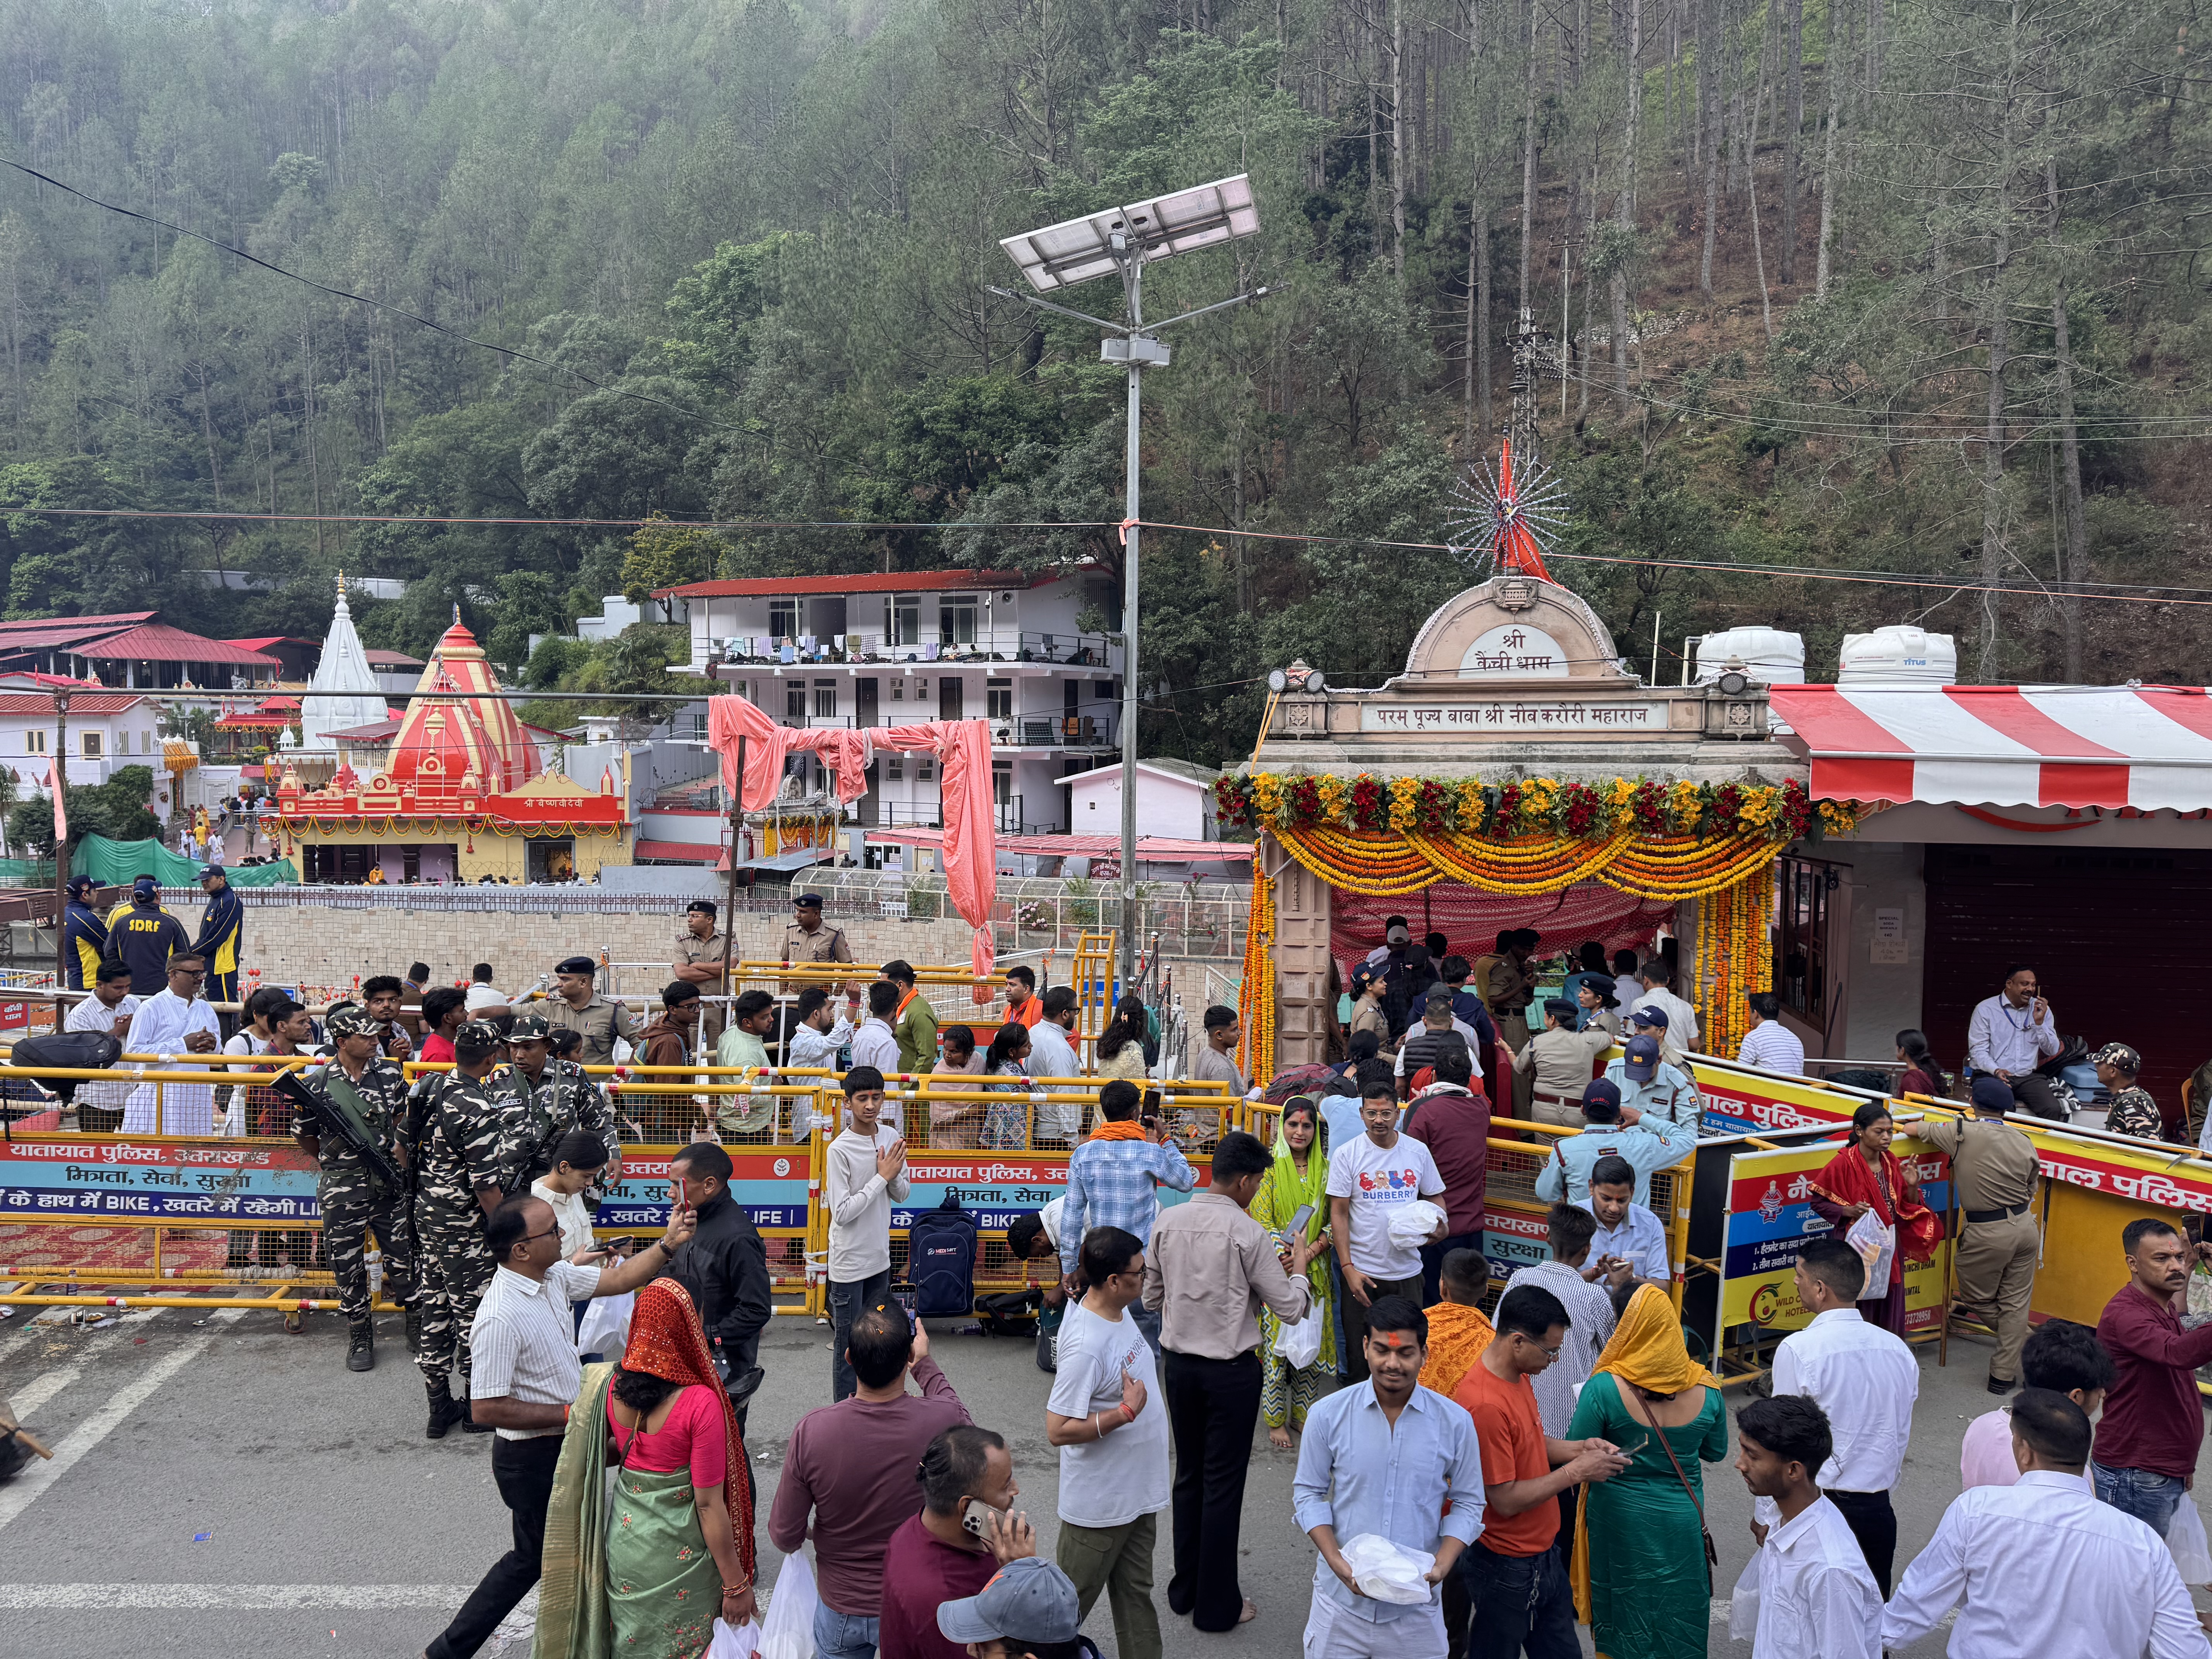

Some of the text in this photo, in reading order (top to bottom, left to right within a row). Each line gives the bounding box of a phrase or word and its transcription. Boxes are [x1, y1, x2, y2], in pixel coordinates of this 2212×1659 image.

[1503, 629, 1526, 649] श्री
[1516, 656, 1552, 670] धाम
[1377, 703, 1648, 730] परम् पूज्य बाबा श्री नीब करौरी महाराज
[524, 798, 535, 807] श्री
[129, 919, 161, 933] SDRF
[10, 1144, 96, 1158] यातायात
[101, 1143, 167, 1163] पुलिस,
[65, 1166, 134, 1185] मित्रता,
[141, 1169, 189, 1188] सेवा,
[977, 1163, 1037, 1183] पुलिस,
[1363, 1190, 1414, 1199] BURBERRY
[8, 1190, 33, 1206] के
[37, 1194, 76, 1208] हाथ
[80, 1191, 102, 1208] में
[163, 1196, 215, 1212] खतरे
[220, 1197, 240, 1213] में
[244, 1198, 296, 1215] रहेगी
[611, 1207, 663, 1223] खतरे
[744, 1210, 782, 1224] IFE
[892, 1211, 914, 1226] के
[1491, 1238, 1546, 1259] सुरक्षा
[1771, 1254, 1787, 1267] सवारी
[1905, 1262, 1920, 1273] AINCHI
[1776, 1296, 1794, 1307] WILD
[1785, 1306, 1811, 1317] HOTEL
[1048, 1336, 1057, 1369] fastrack
